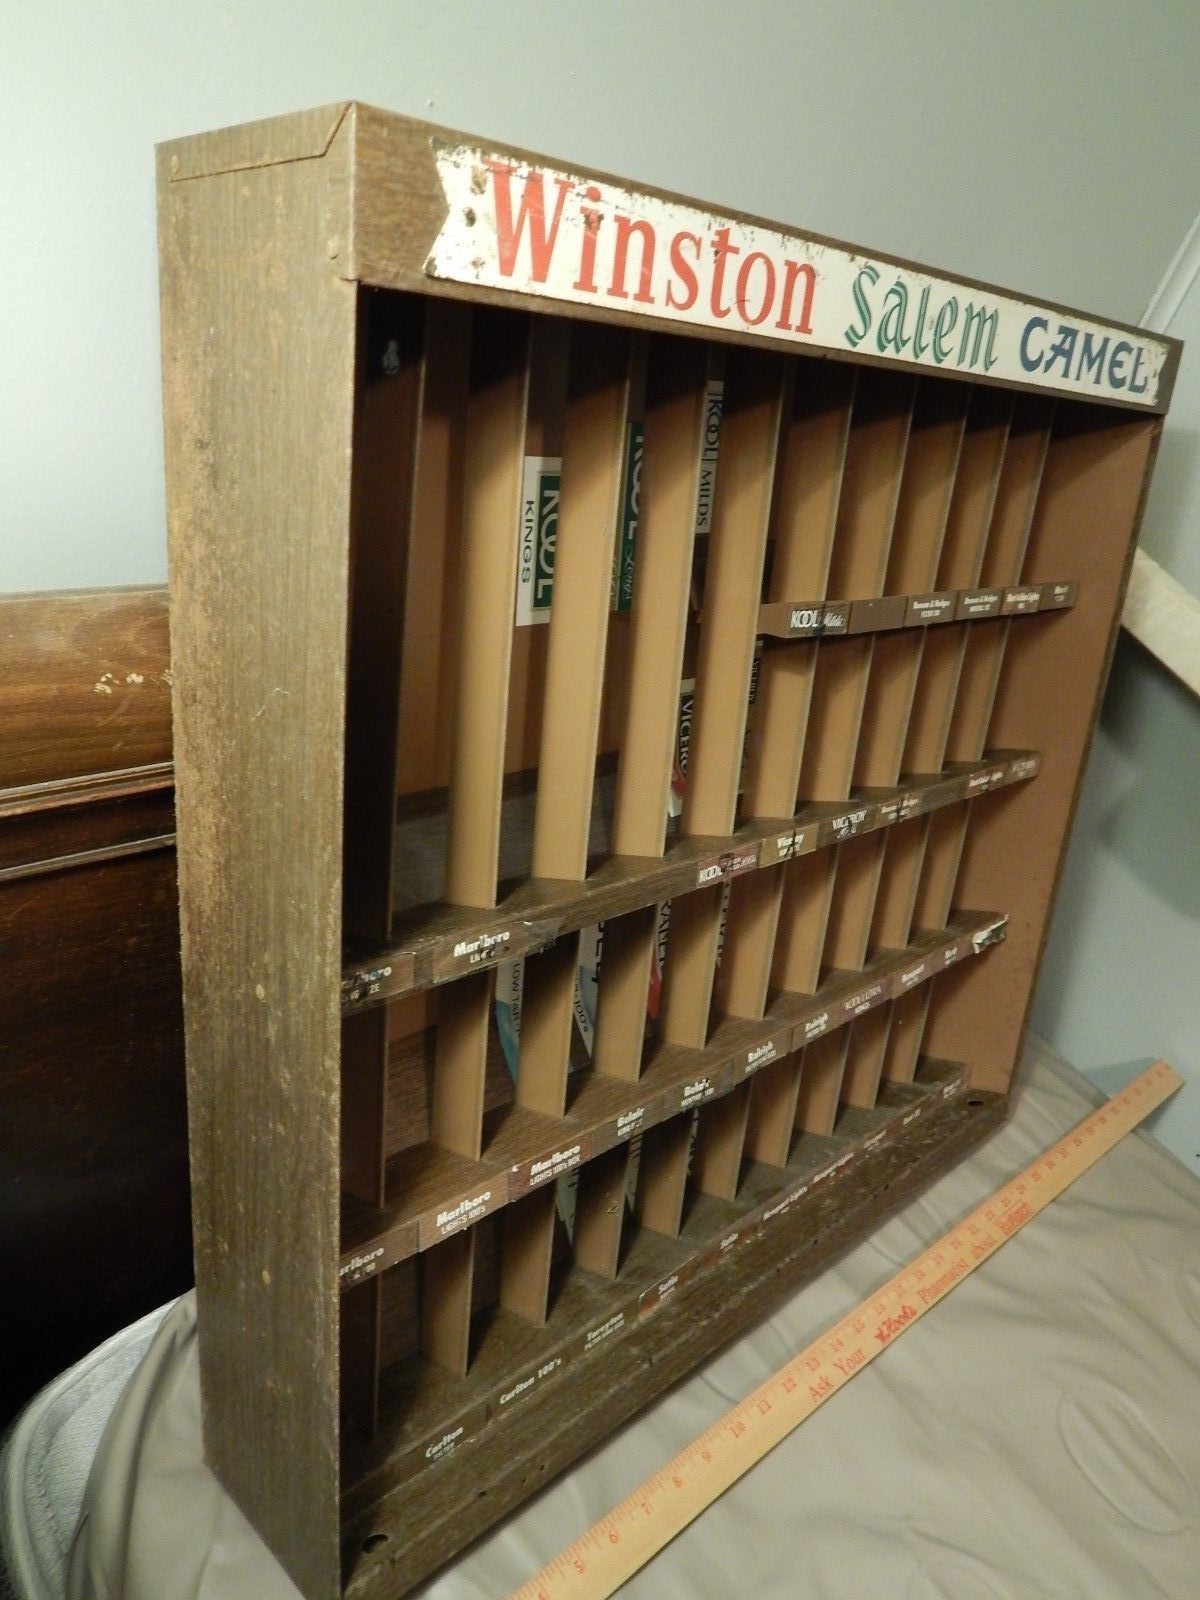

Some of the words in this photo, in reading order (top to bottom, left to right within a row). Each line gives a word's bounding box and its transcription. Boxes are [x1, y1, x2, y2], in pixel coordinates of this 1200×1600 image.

[483, 160, 816, 335] Winston
[843, 264, 999, 372] Salem
[1019, 315, 1148, 394] CAMEL
[702, 399, 722, 455] KOOL
[696, 469, 713, 527] MILDS
[521, 500, 535, 583] KINGS
[537, 489, 561, 599] KOOL
[790, 610, 818, 628] KOOL
[453, 931, 511, 958] Marlboro
[531, 1145, 581, 1176] Marlboro
[436, 1191, 491, 1226] Marlboro
[500, 1377, 534, 1404] Carlton
[808, 1376, 835, 1403] Ask
[832, 1347, 867, 1377] Your
[425, 1427, 464, 1458] Carlton
[672, 1476, 684, 1489] 8
[608, 1529, 620, 1544] 6
[574, 1560, 585, 1575] 5
